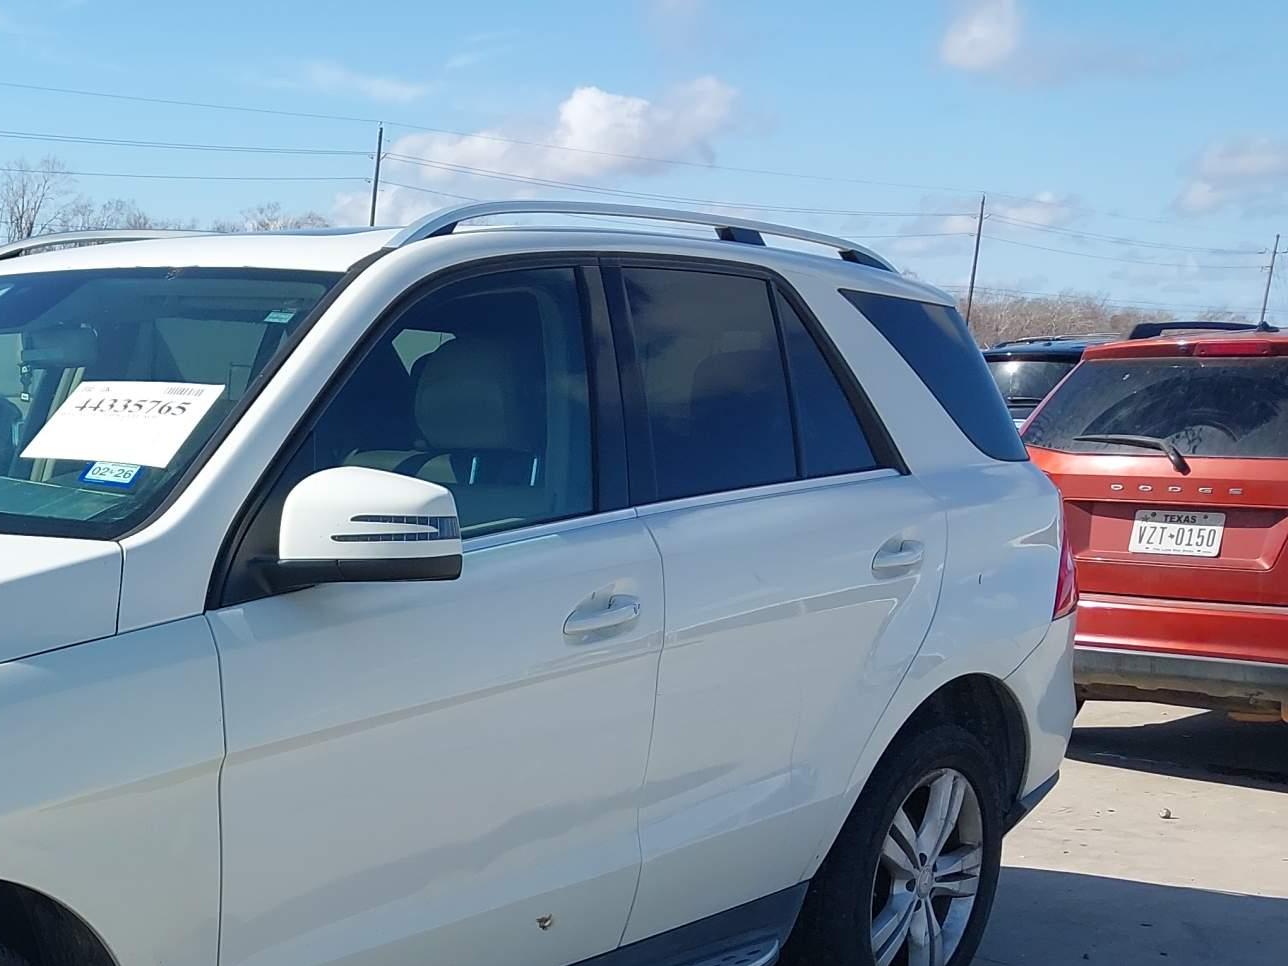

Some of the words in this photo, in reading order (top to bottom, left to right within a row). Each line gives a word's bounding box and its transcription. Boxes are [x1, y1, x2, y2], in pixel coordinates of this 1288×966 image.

[74, 397, 193, 416] 44335765
[91, 465, 111, 477] 02
[114, 467, 134, 480] 26
[1110, 483, 1244, 496] DODGE
[1163, 514, 1197, 524] TEXAS
